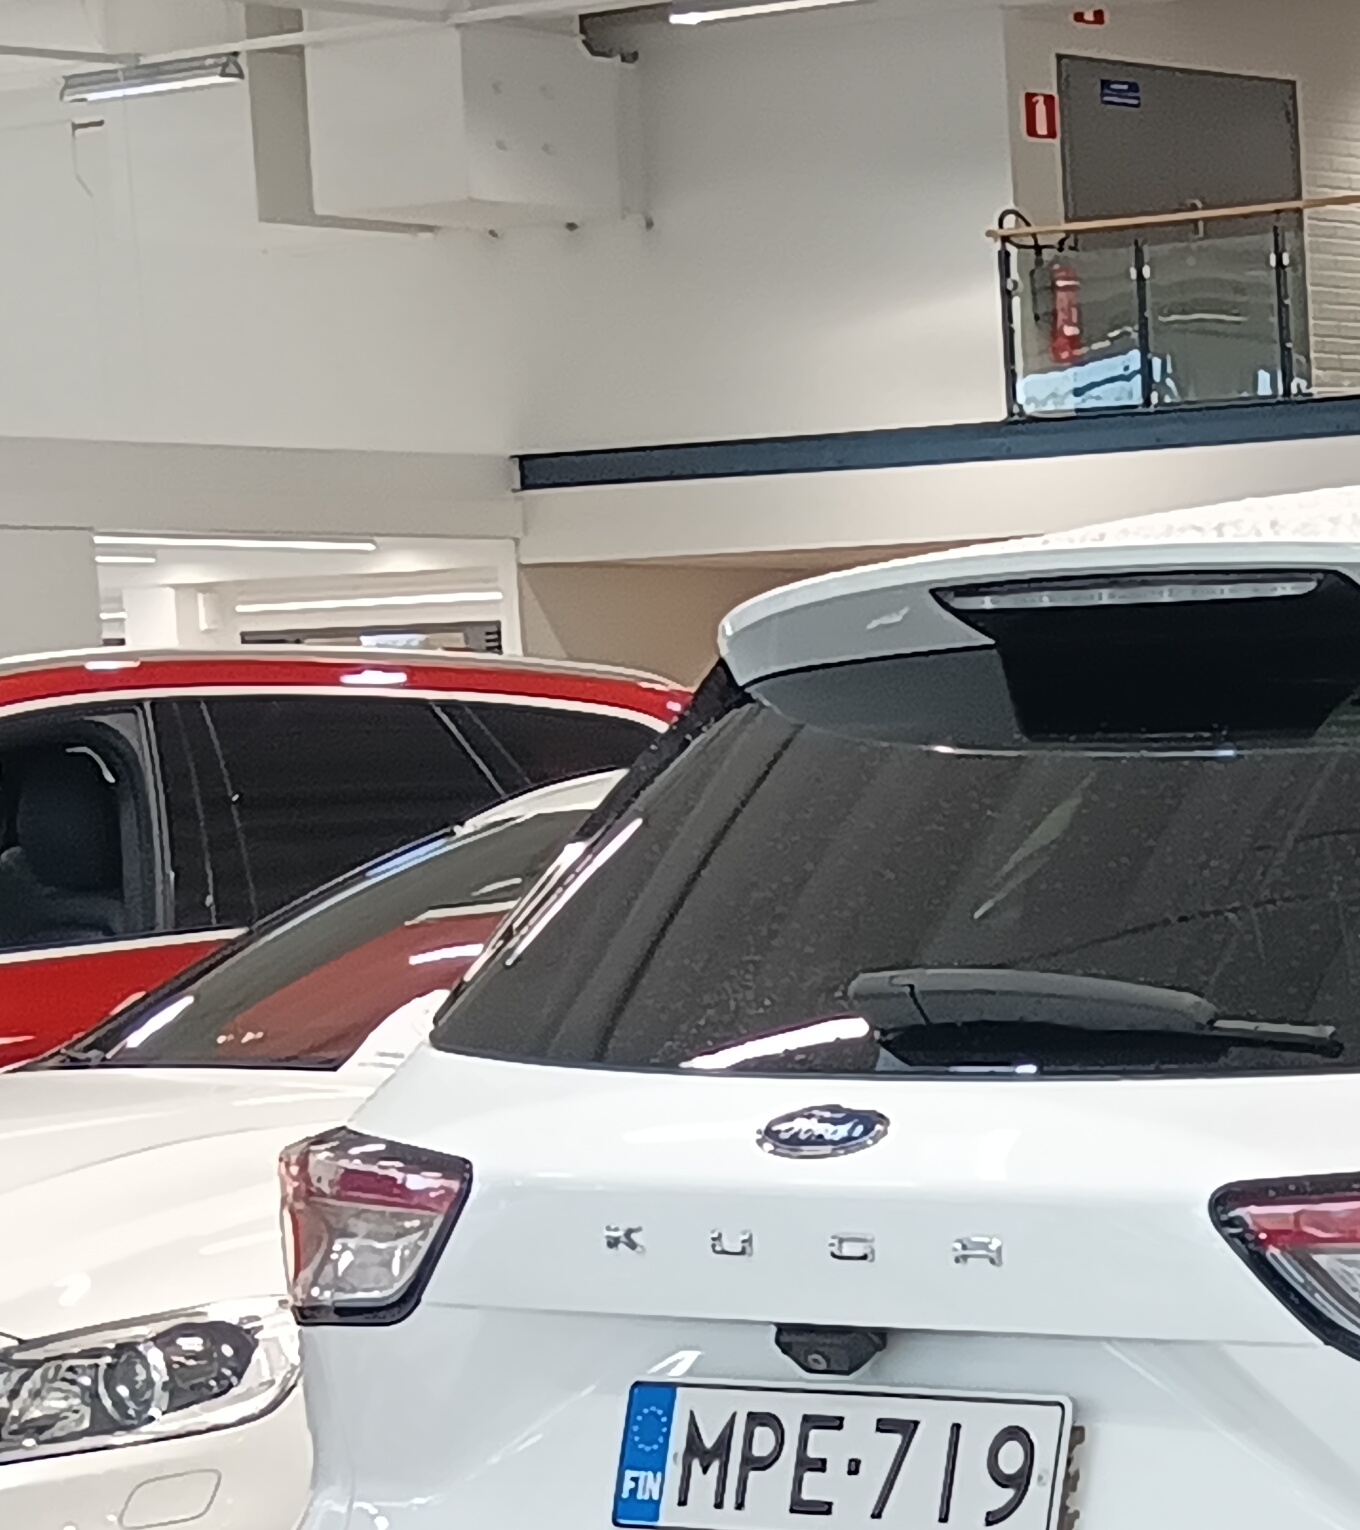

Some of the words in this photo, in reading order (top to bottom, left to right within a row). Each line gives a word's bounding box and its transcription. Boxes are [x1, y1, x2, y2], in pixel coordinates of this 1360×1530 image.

[771, 1109, 865, 1141] Ford
[604, 1222, 1004, 1268] KUGA
[622, 1468, 661, 1501] FIN
